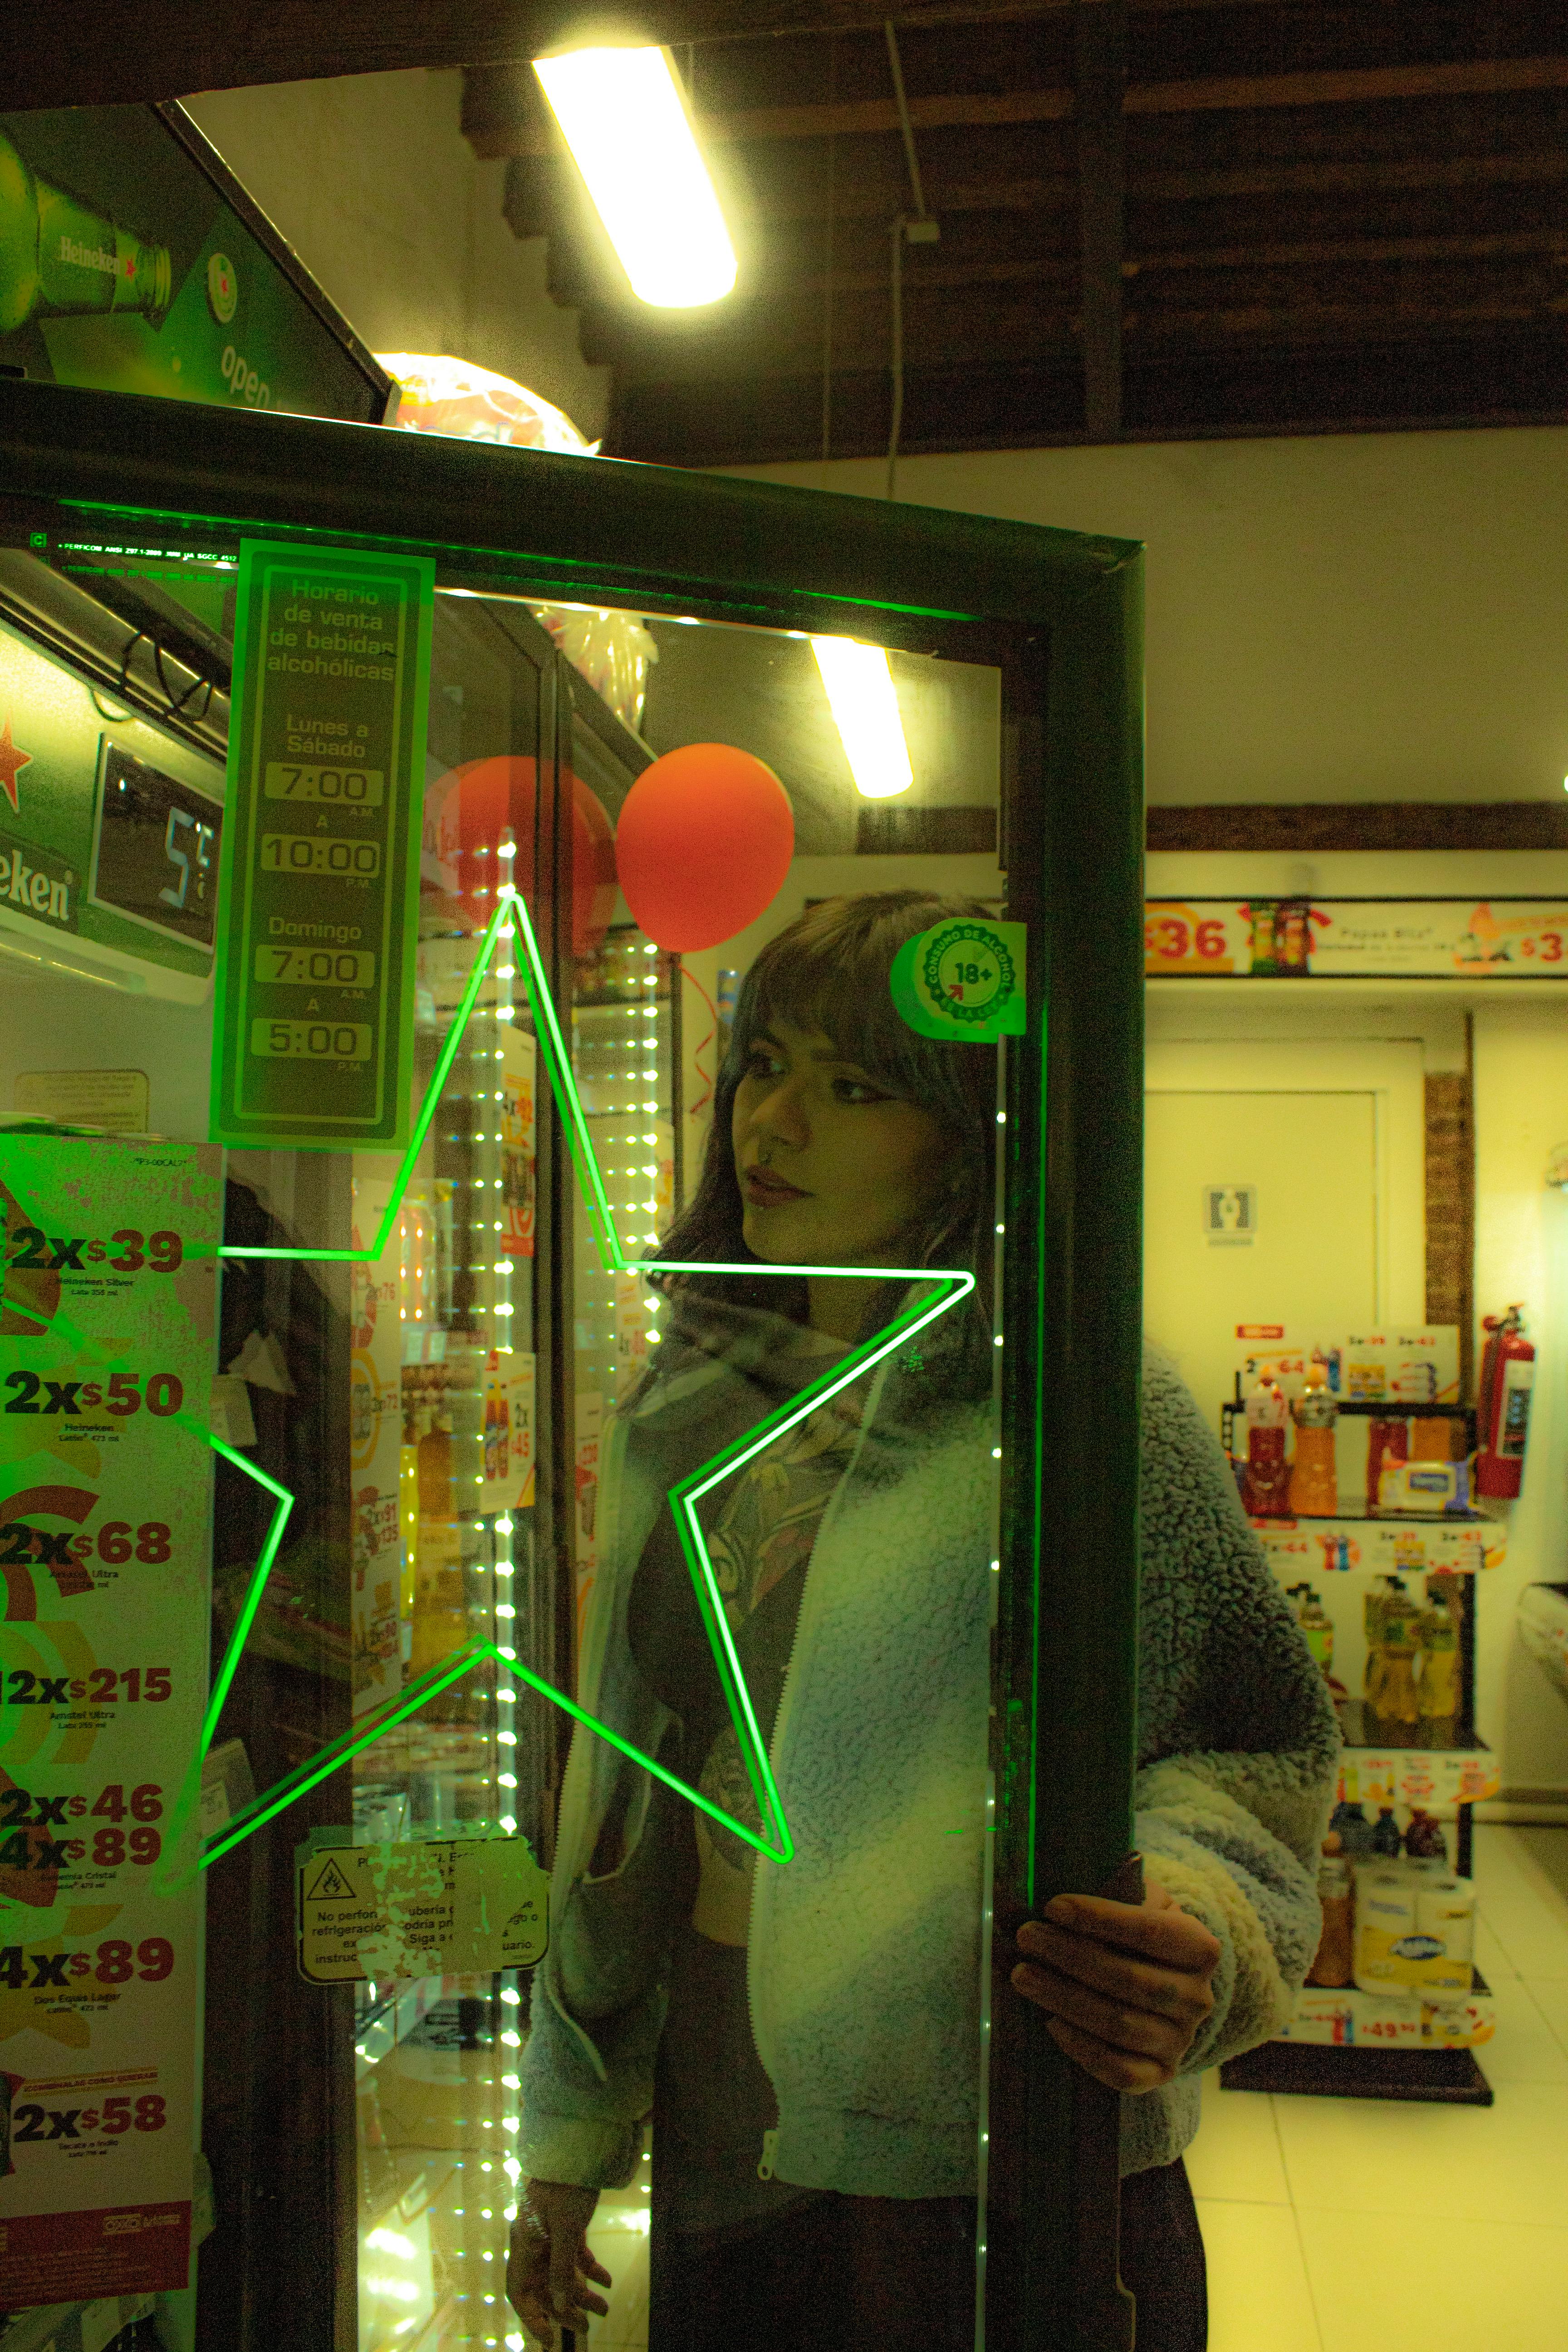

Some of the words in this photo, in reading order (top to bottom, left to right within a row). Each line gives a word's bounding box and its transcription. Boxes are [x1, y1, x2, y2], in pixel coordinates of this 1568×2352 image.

[61, 235, 120, 274] Heineken
[197, 553, 218, 561] SGCC
[292, 579, 378, 605] Horario
[284, 603, 311, 623] de
[320, 611, 383, 631] venta
[270, 627, 298, 647] de
[307, 629, 394, 655] bebidas
[267, 652, 394, 681] alcohólicas
[287, 714, 348, 736] Lunes
[356, 724, 369, 738] a
[287, 735, 366, 758] Sábado
[282, 767, 368, 800] 7:00
[316, 814, 328, 828] A
[266, 838, 377, 873] 10:00
[269, 916, 362, 943] Domingo
[272, 950, 359, 982] 7:00
[928, 931, 961, 984] CONSUMO
[964, 929, 980, 939] DE
[982, 936, 1011, 988] ALCOHOL
[955, 962, 992, 985] 18+
[307, 998, 319, 1012] A
[269, 1024, 358, 1055] 5:00
[0, 1668, 172, 1705] 2x$215
[317, 1911, 334, 1922] No
[409, 1905, 446, 1916] ubería
[404, 1919, 435, 1931] odría
[409, 1932, 435, 1945] Siga
[315, 1953, 357, 1964] instruc
